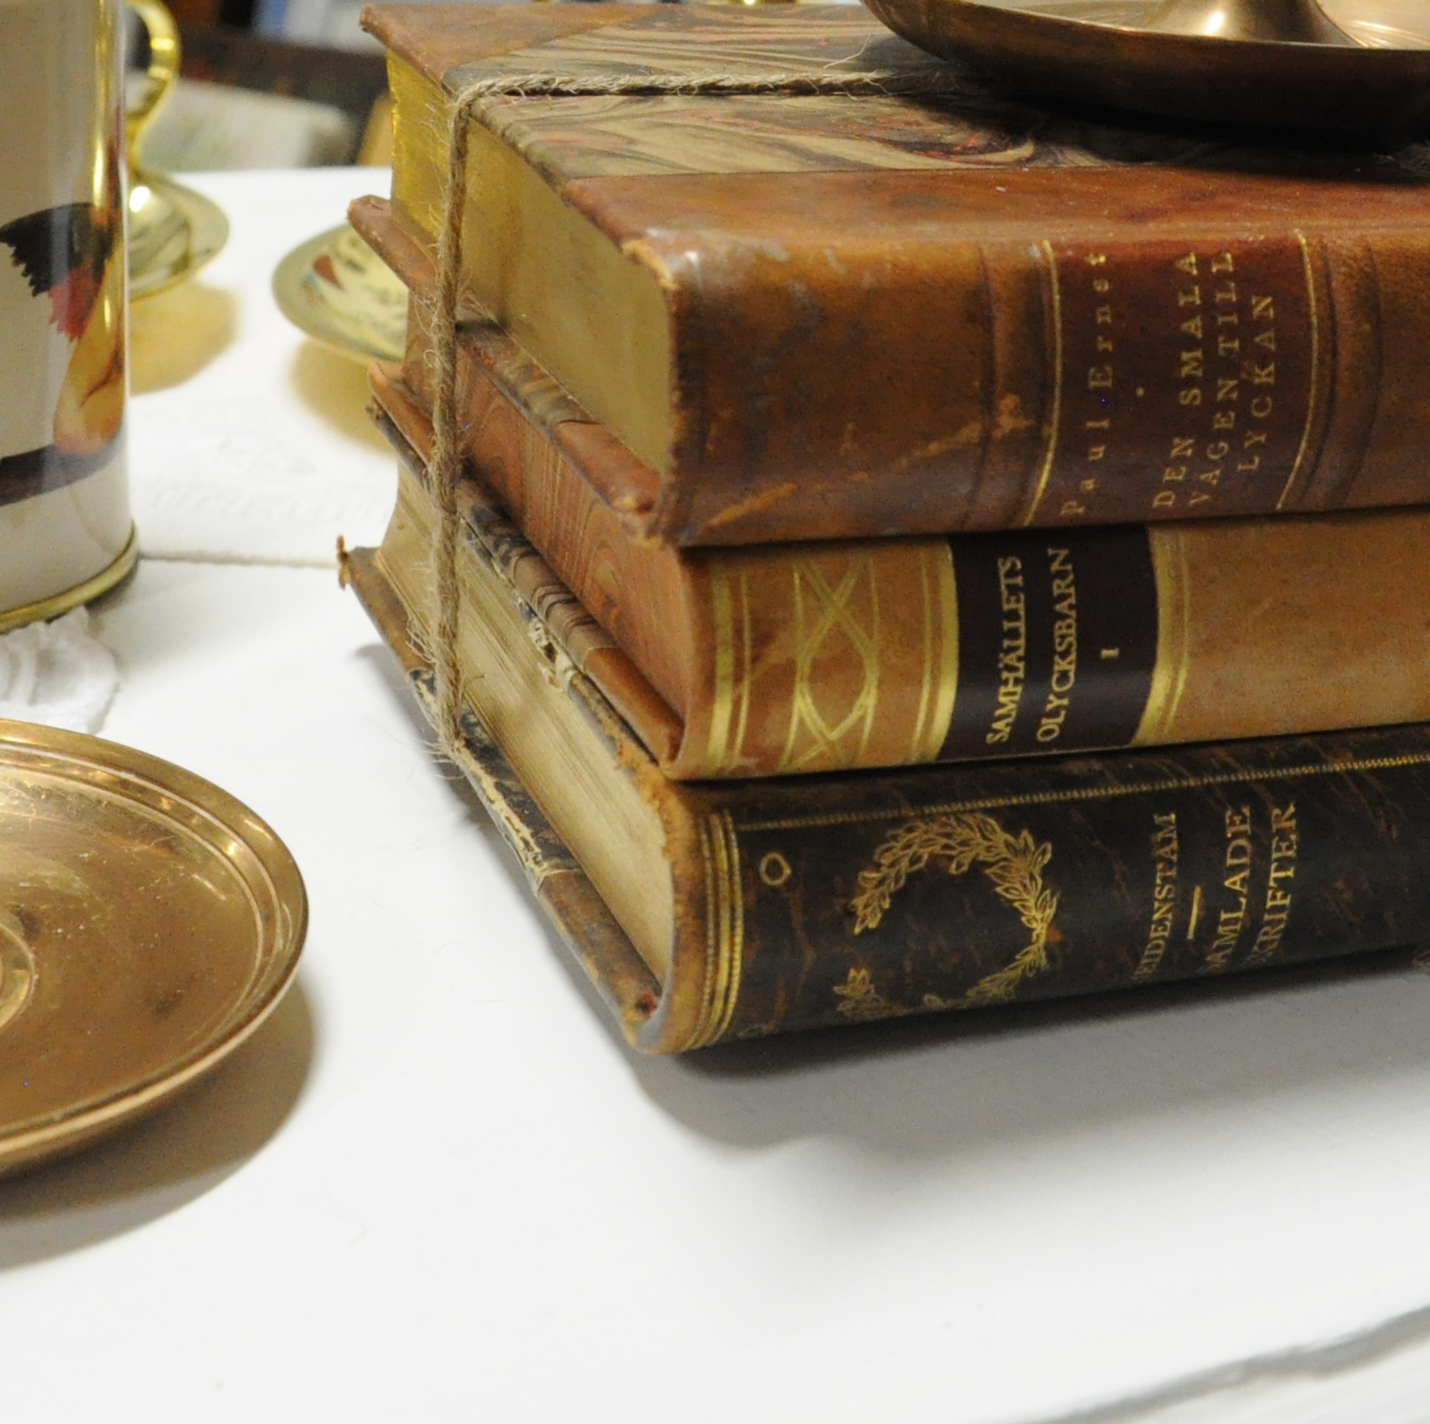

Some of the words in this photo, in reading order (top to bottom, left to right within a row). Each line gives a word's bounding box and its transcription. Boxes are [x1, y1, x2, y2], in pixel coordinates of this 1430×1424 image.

[1085, 254, 1114, 390] Ernst
[1152, 436, 1196, 508] DEN
[1175, 251, 1204, 407] SMALA
[1211, 252, 1240, 356] TILL
[1237, 294, 1276, 472] LYCKAN
[1061, 418, 1111, 515] Paul
[986, 556, 1025, 744] SAMHÄLLETS
[1036, 547, 1077, 743] OLYCKSBARN
[1201, 804, 1252, 973] AMLADE
[1245, 801, 1298, 965] KRIFTER
